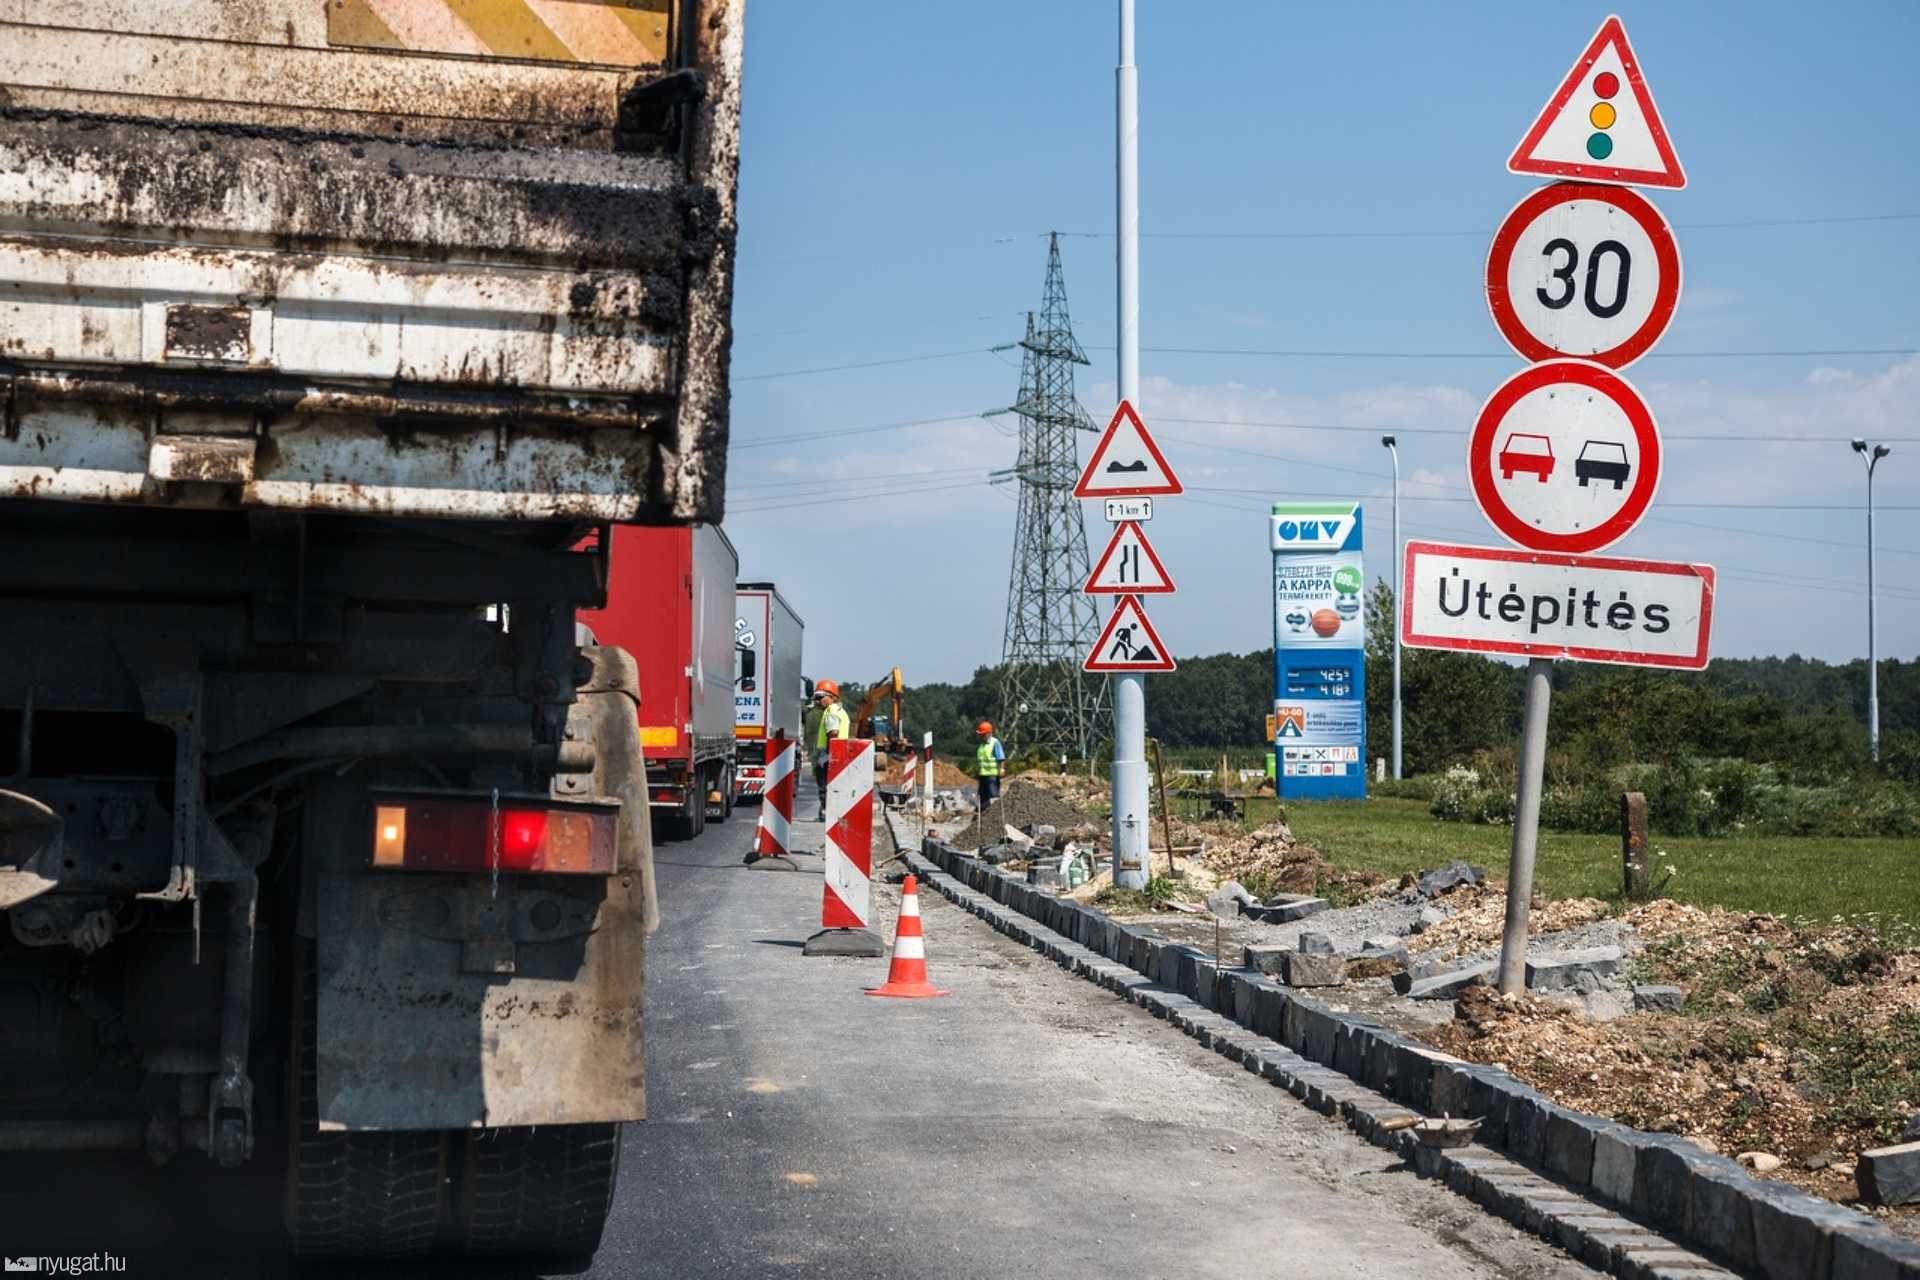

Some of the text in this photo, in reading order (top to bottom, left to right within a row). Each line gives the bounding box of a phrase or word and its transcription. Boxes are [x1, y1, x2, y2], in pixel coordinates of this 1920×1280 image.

[1536, 237, 1631, 319] 30
[1126, 504, 1139, 515] km
[1278, 520, 1342, 541] OMV
[1279, 579, 1288, 591] A
[1290, 579, 1332, 591] KAPPA
